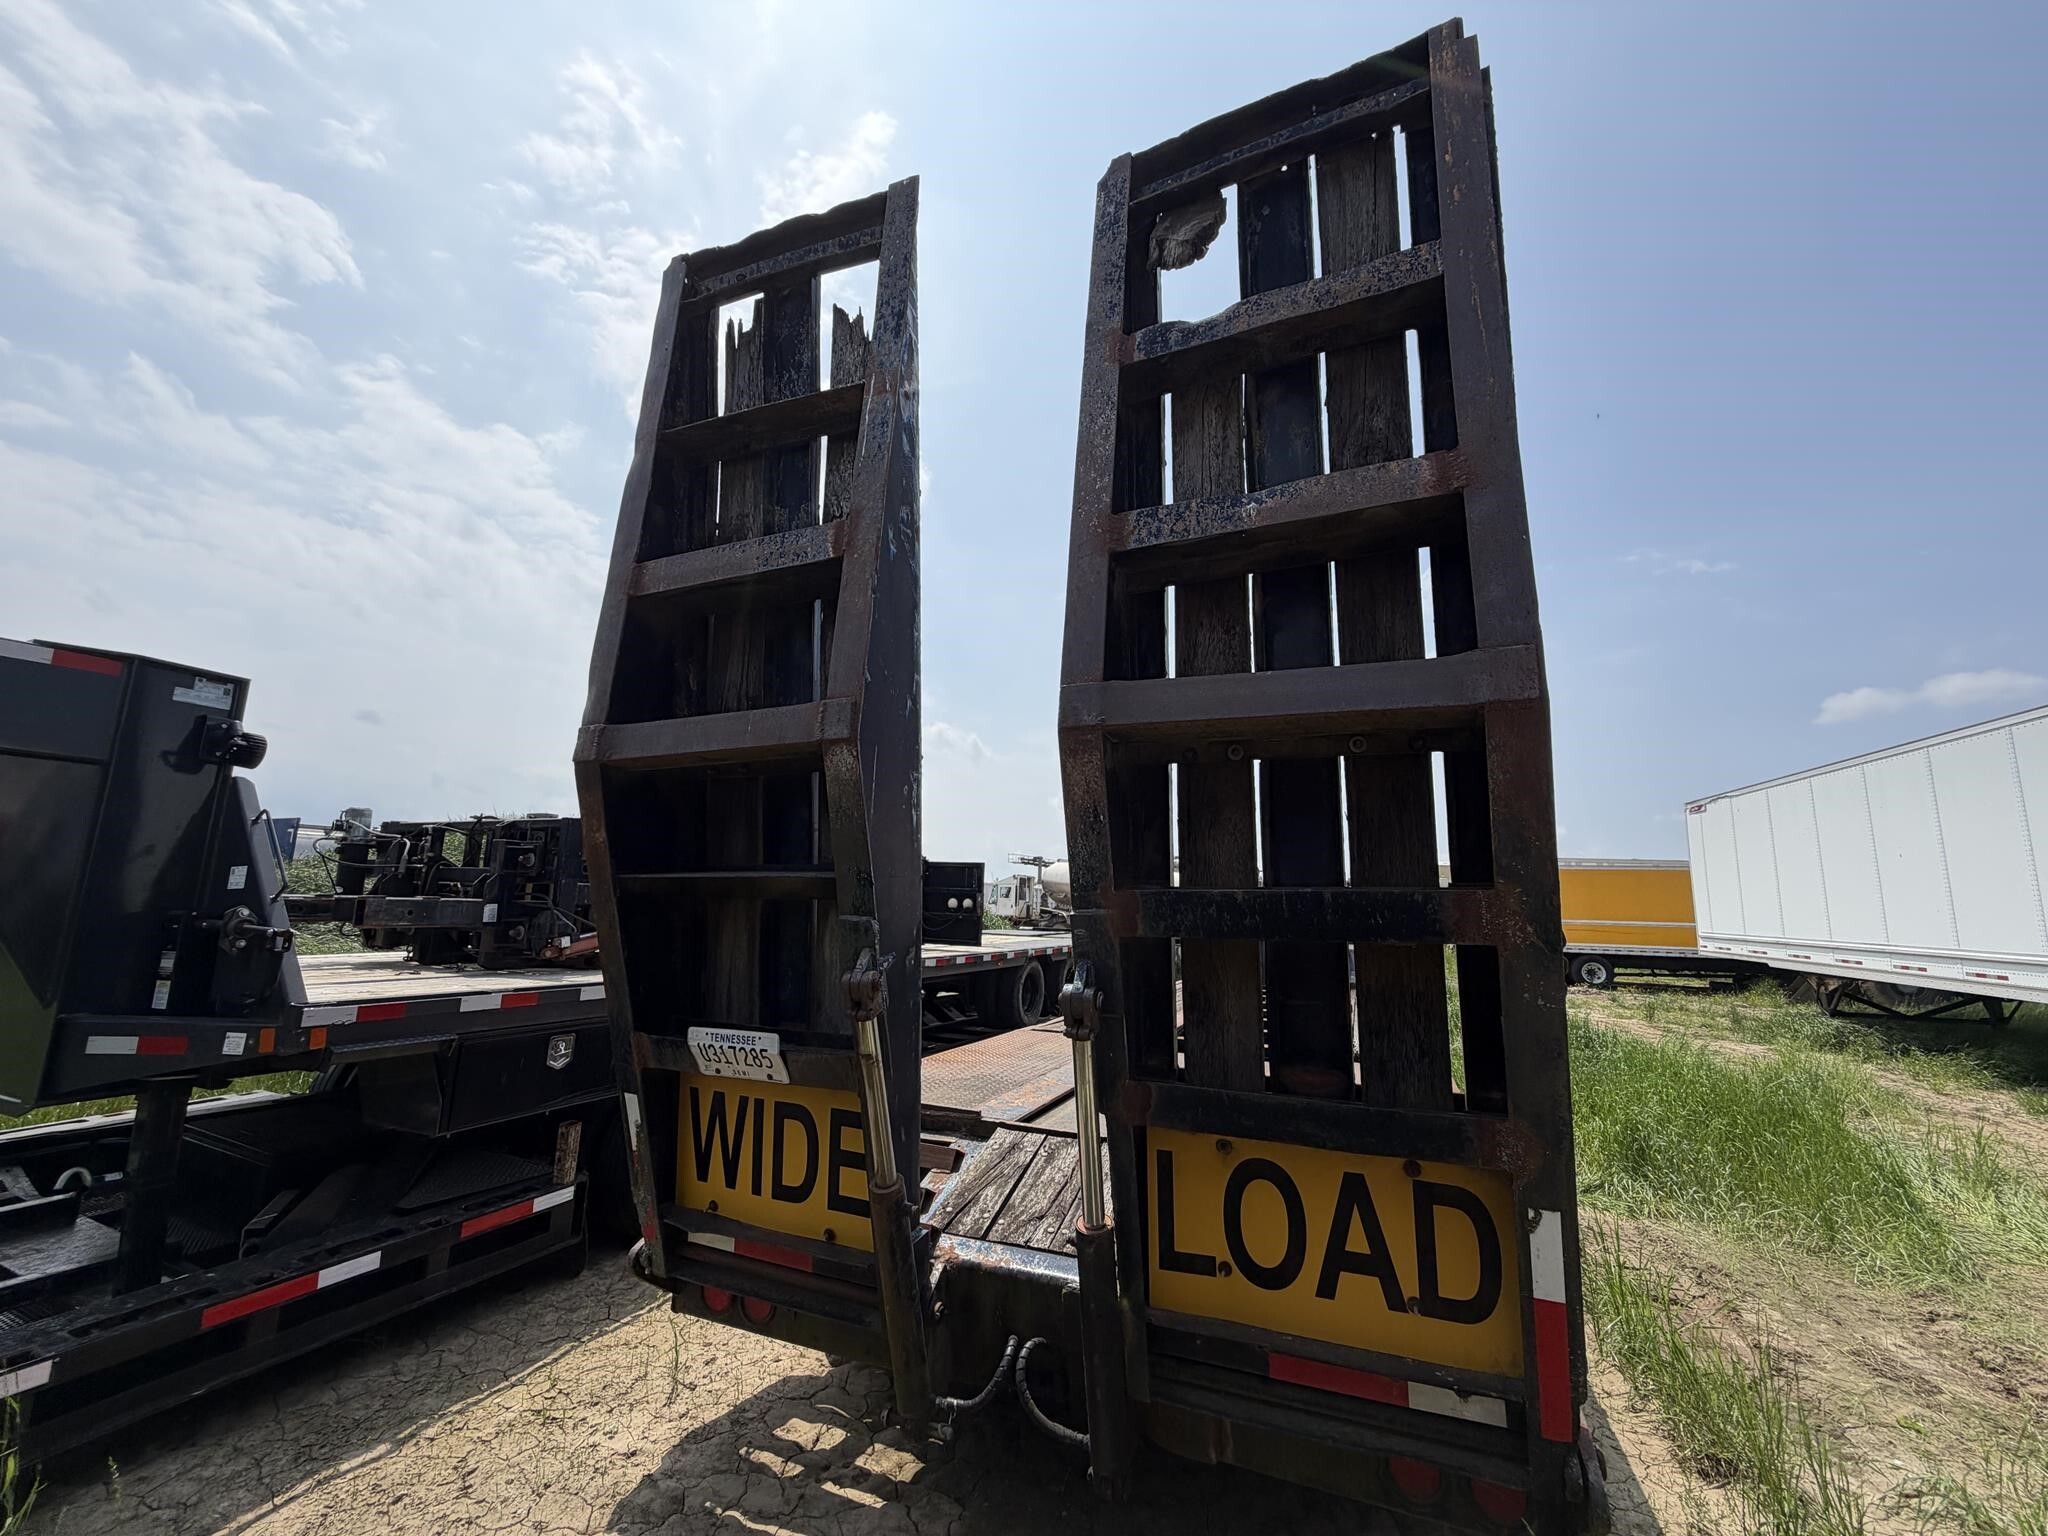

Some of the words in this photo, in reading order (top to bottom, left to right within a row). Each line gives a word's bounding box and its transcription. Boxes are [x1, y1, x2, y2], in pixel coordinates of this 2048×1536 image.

[697, 1042, 774, 1069] U317285
[710, 1032, 757, 1046] TENNESSEE
[689, 1086, 871, 1218] WIDE
[1156, 1149, 1502, 1325] LOAD
